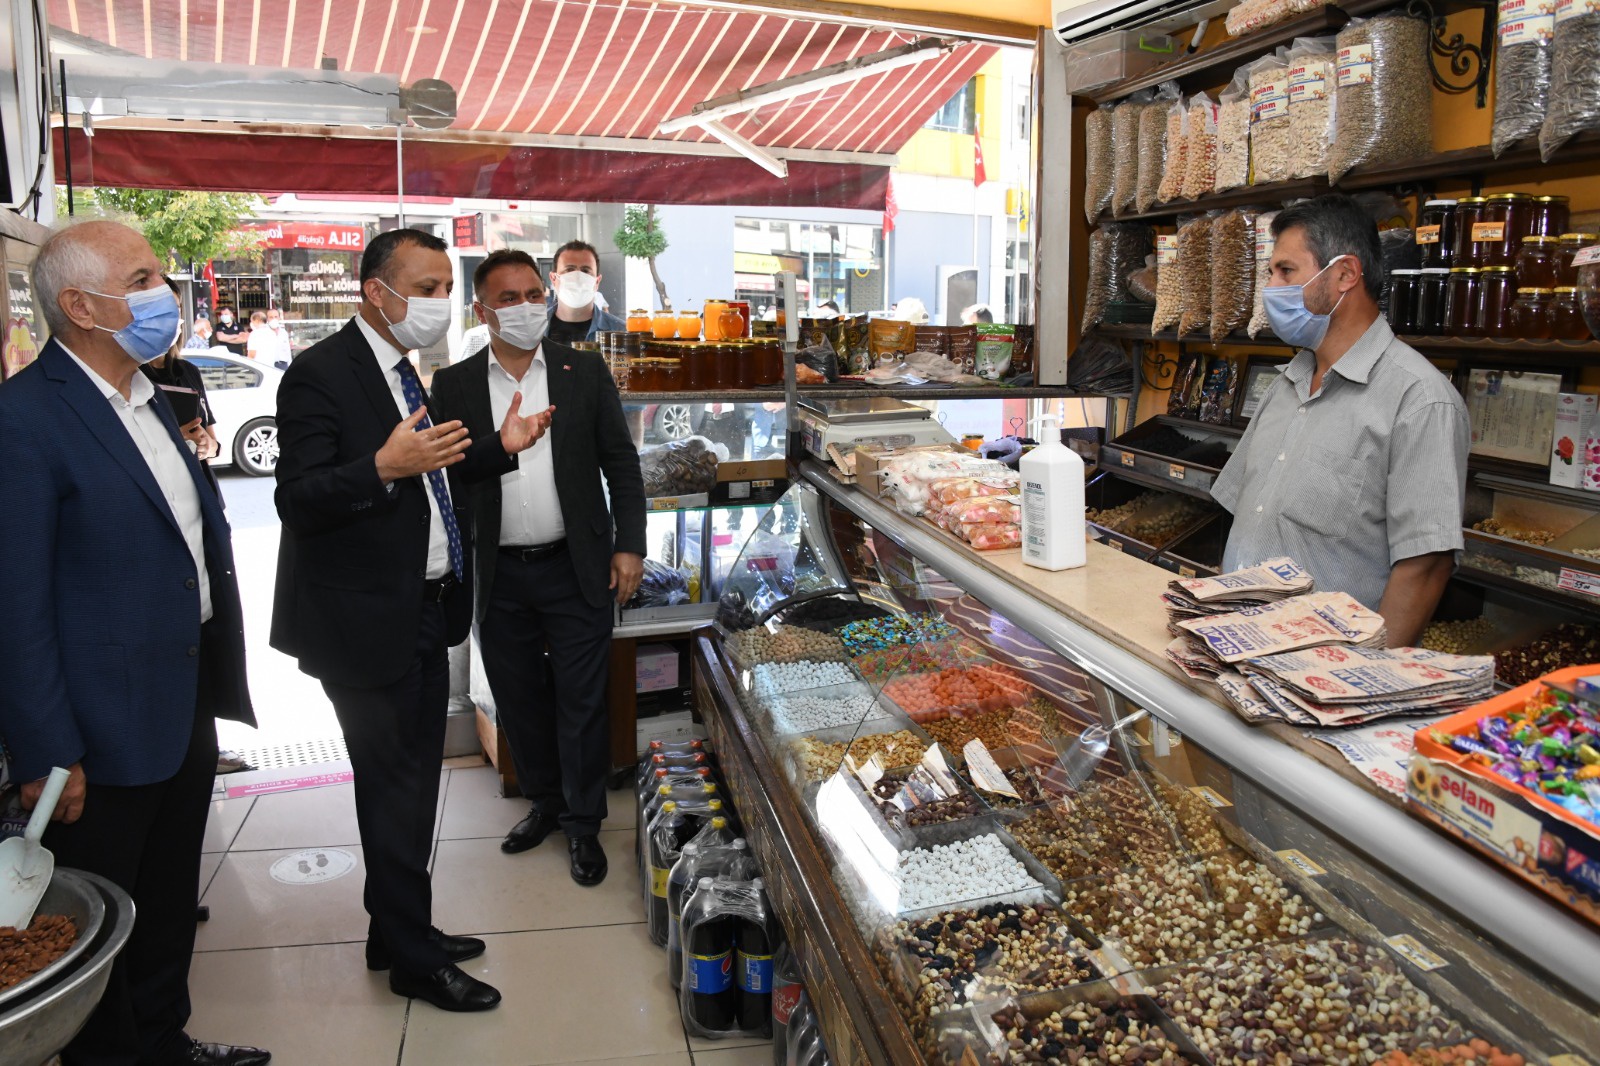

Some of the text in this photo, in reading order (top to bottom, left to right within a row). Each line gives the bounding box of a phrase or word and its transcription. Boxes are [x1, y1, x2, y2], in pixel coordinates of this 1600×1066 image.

[308, 260, 345, 276] GÜMÜŞ
[292, 278, 326, 292] PESTİL
[290, 295, 316, 304] FABRİKA
[1198, 626, 1240, 656] SELAM
[1440, 774, 1495, 820] selam
